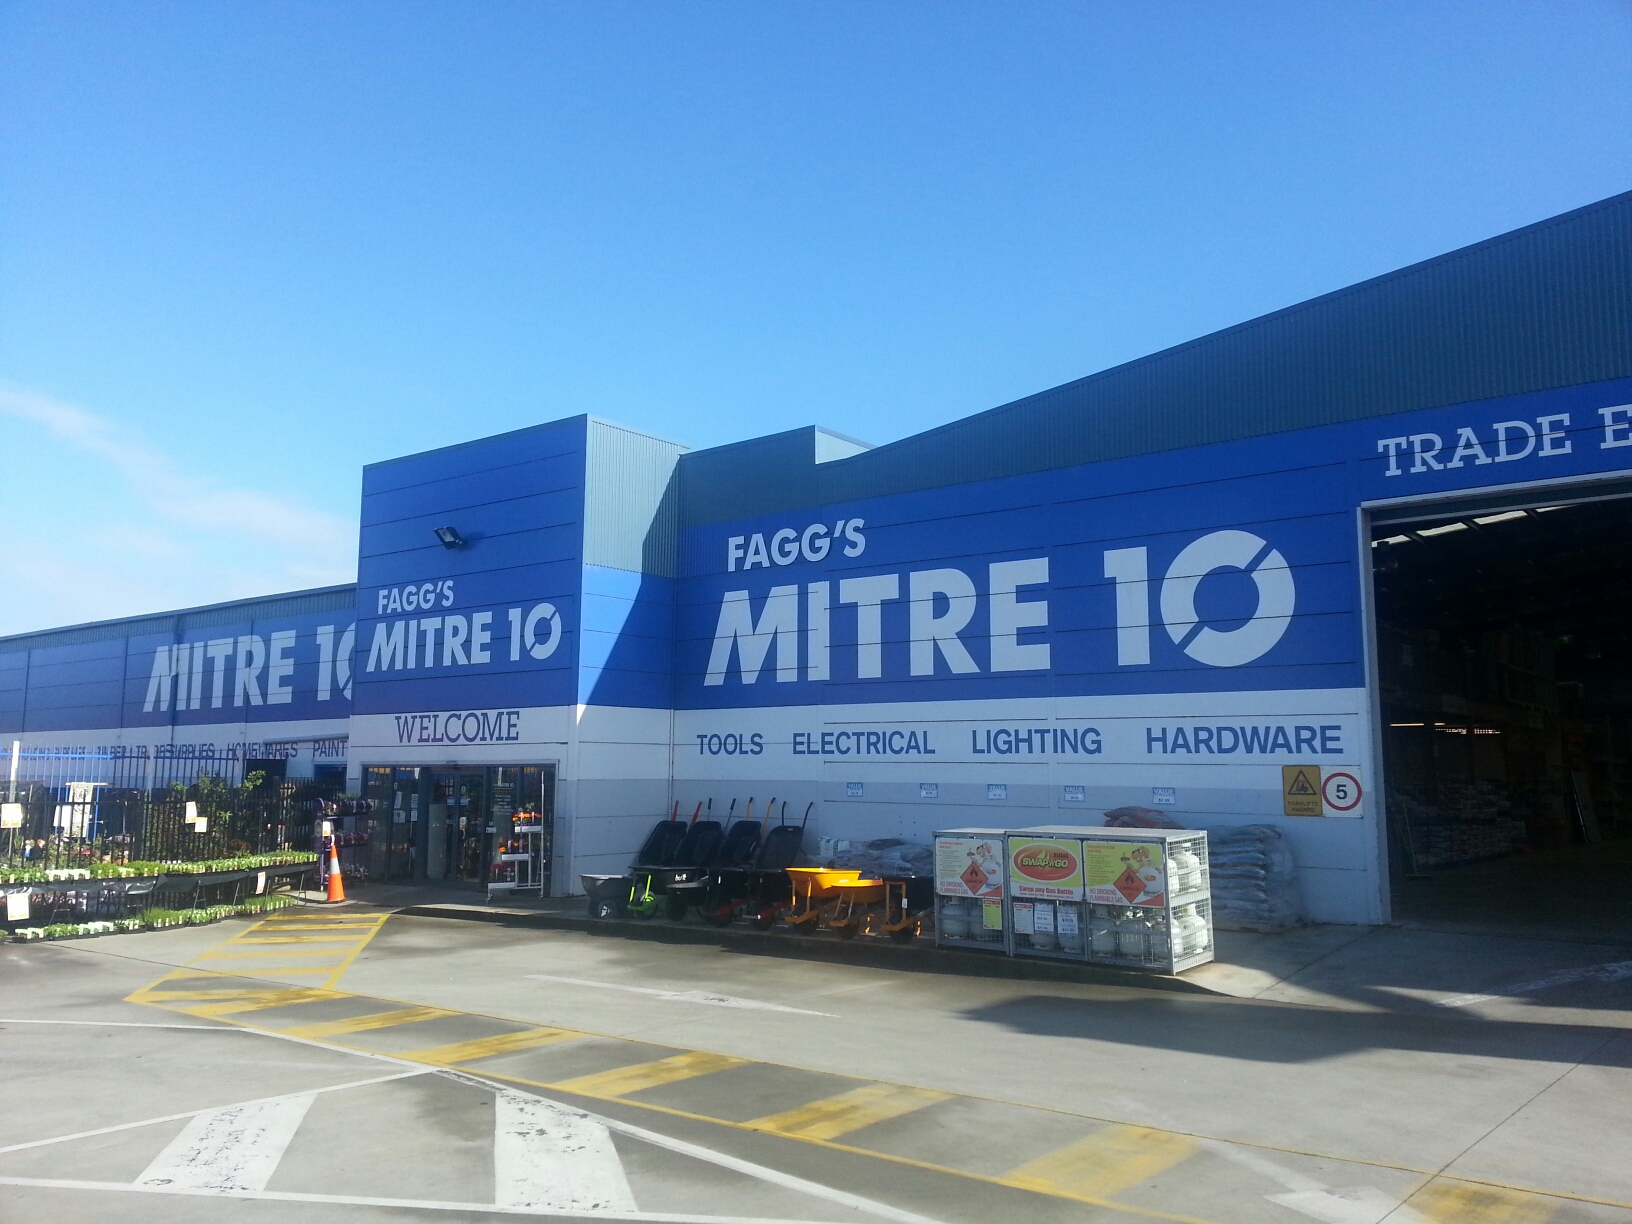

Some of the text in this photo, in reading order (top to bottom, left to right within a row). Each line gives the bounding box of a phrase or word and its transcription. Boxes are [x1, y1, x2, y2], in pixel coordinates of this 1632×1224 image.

[1378, 413, 1572, 476] TRADE
[727, 518, 866, 572] FAGG'S
[377, 580, 454, 615] FAGG'S
[704, 530, 1296, 687] MITRE 10
[366, 602, 562, 673] MITRE 10
[143, 629, 296, 713] MITRE
[313, 740, 348, 758] PAINT
[395, 711, 520, 744] WELCOME
[697, 725, 1344, 756] TOOLS ELECTRICAL LIGHTING HARDWARE
[1336, 784, 1348, 800] 5
